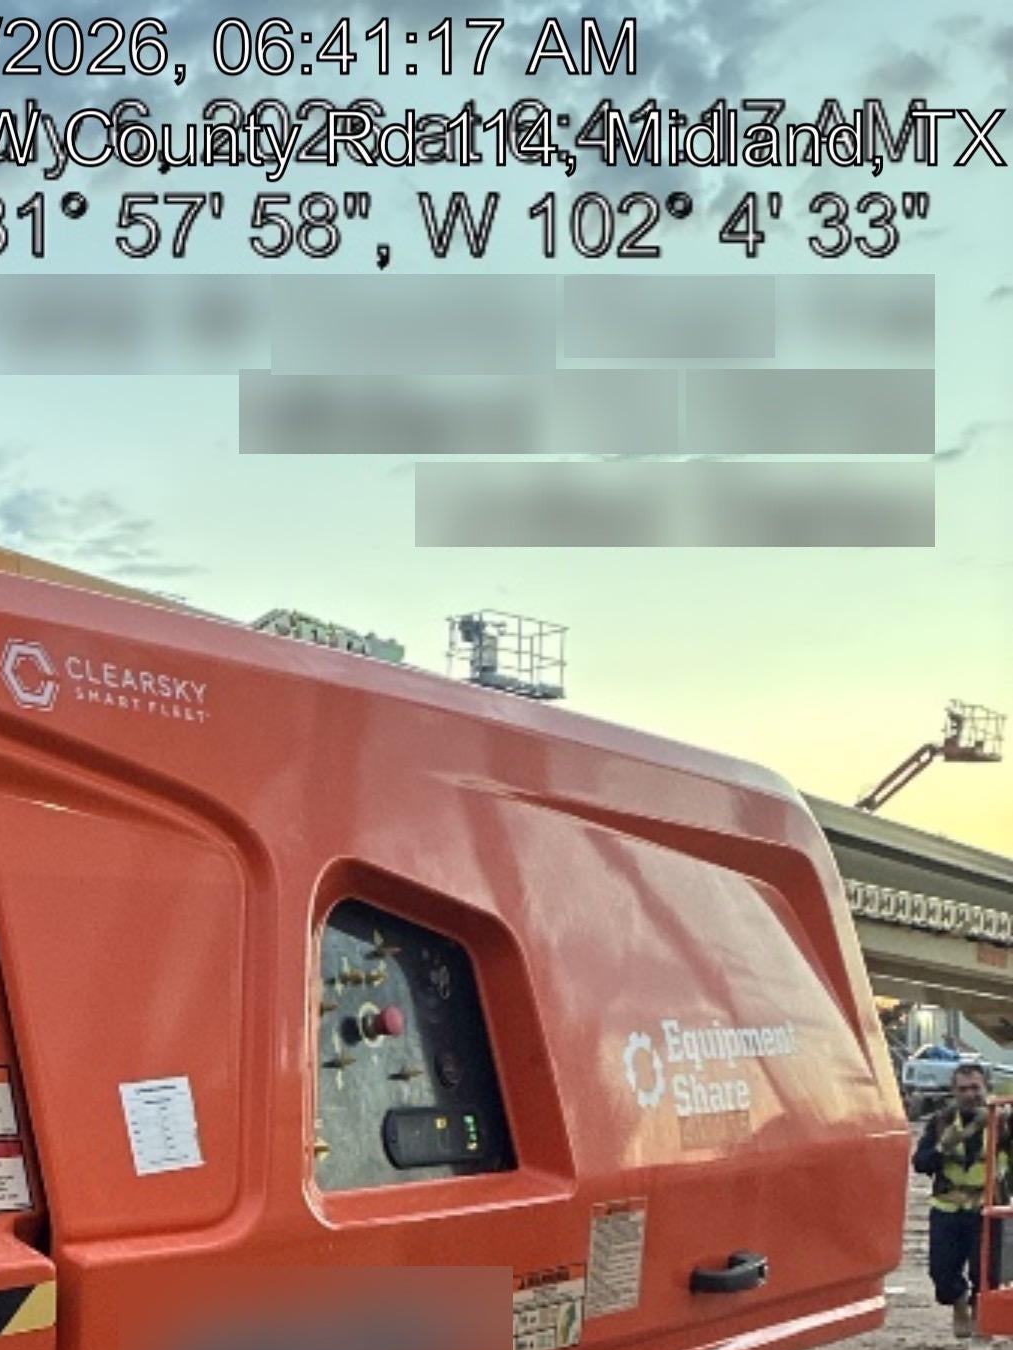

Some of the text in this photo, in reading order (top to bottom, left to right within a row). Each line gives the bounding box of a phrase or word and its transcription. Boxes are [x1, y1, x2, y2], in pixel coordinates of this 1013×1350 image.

[64, 656, 207, 704] CLEARSKY
[75, 687, 141, 712] SMART
[661, 1017, 797, 1072] Equipment
[673, 1072, 751, 1117] Share
